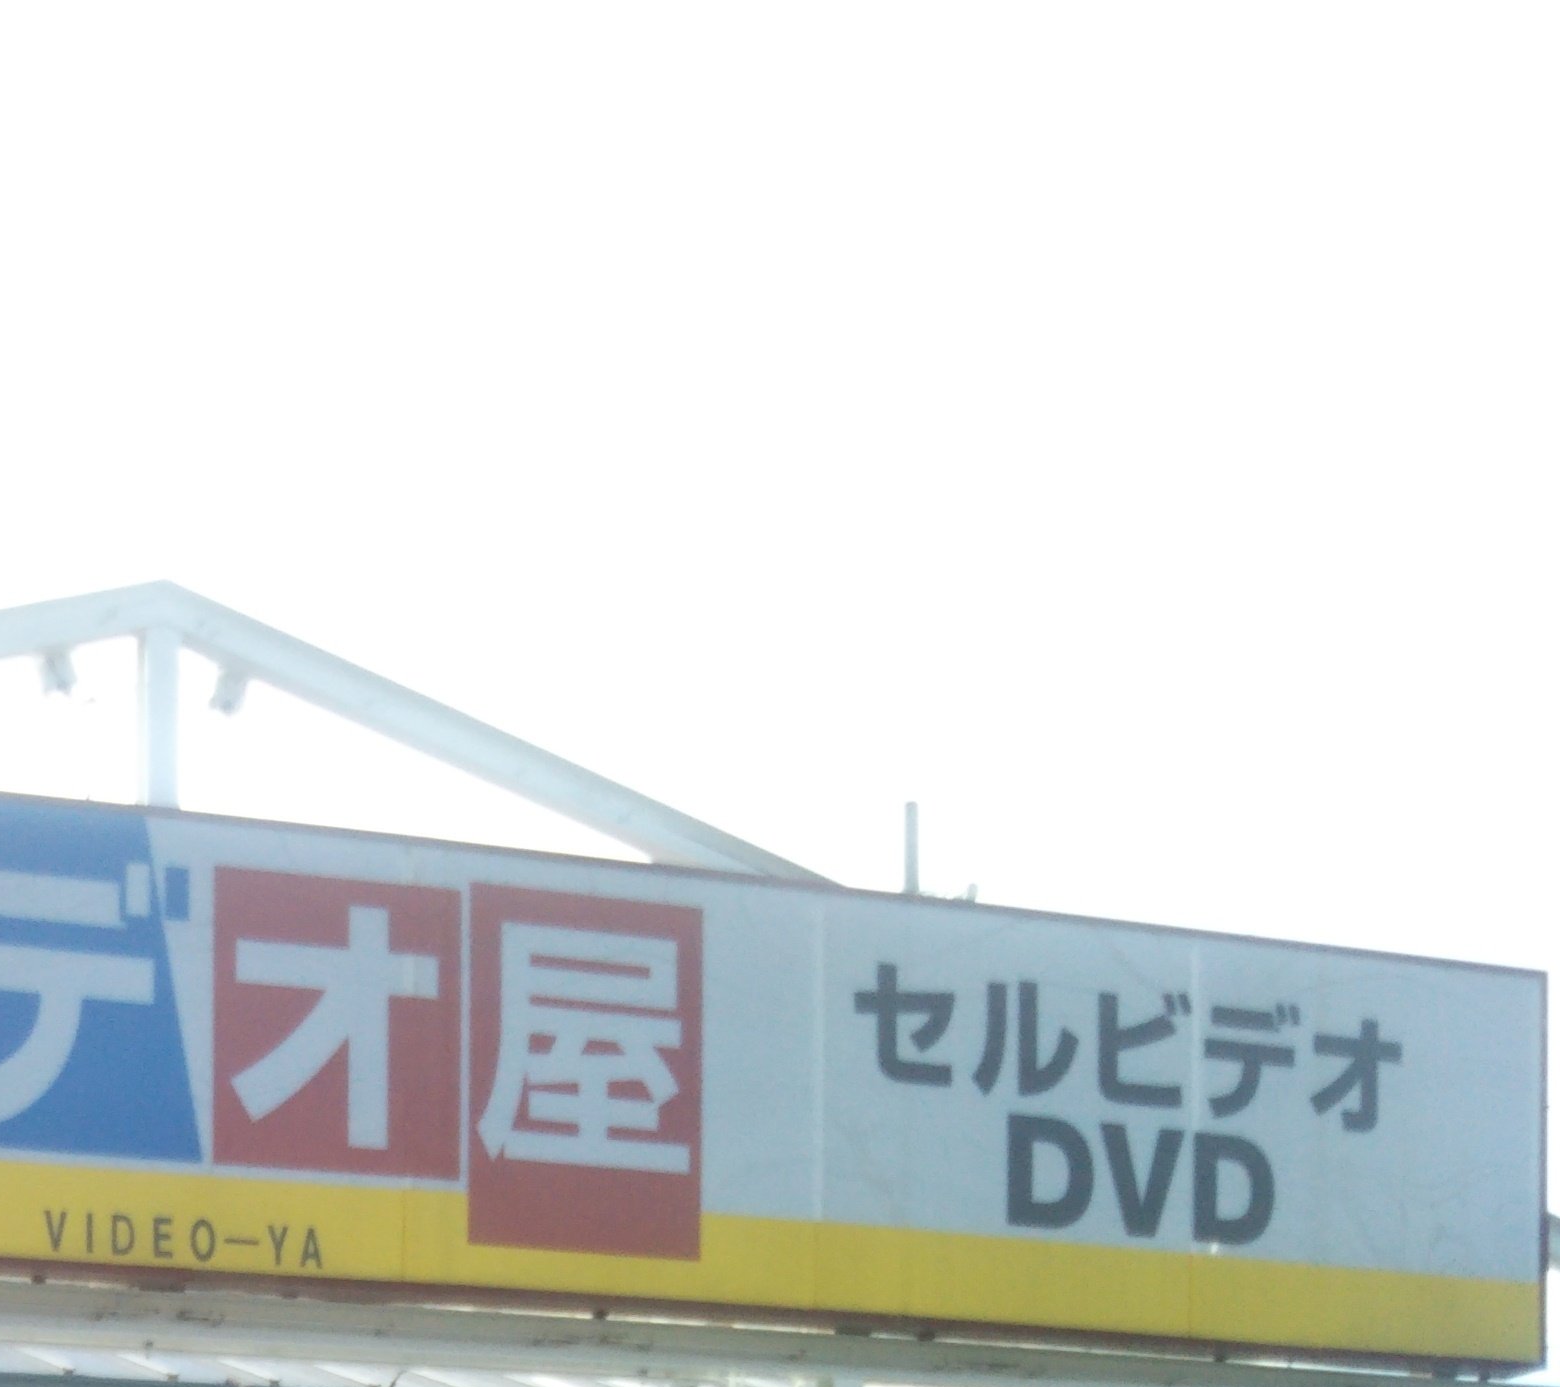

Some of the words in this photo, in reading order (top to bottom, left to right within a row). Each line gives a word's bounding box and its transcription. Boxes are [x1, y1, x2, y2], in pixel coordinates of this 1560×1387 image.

[853, 962, 1403, 1133] セルビデオ
[1007, 1114, 1275, 1245] DVD
